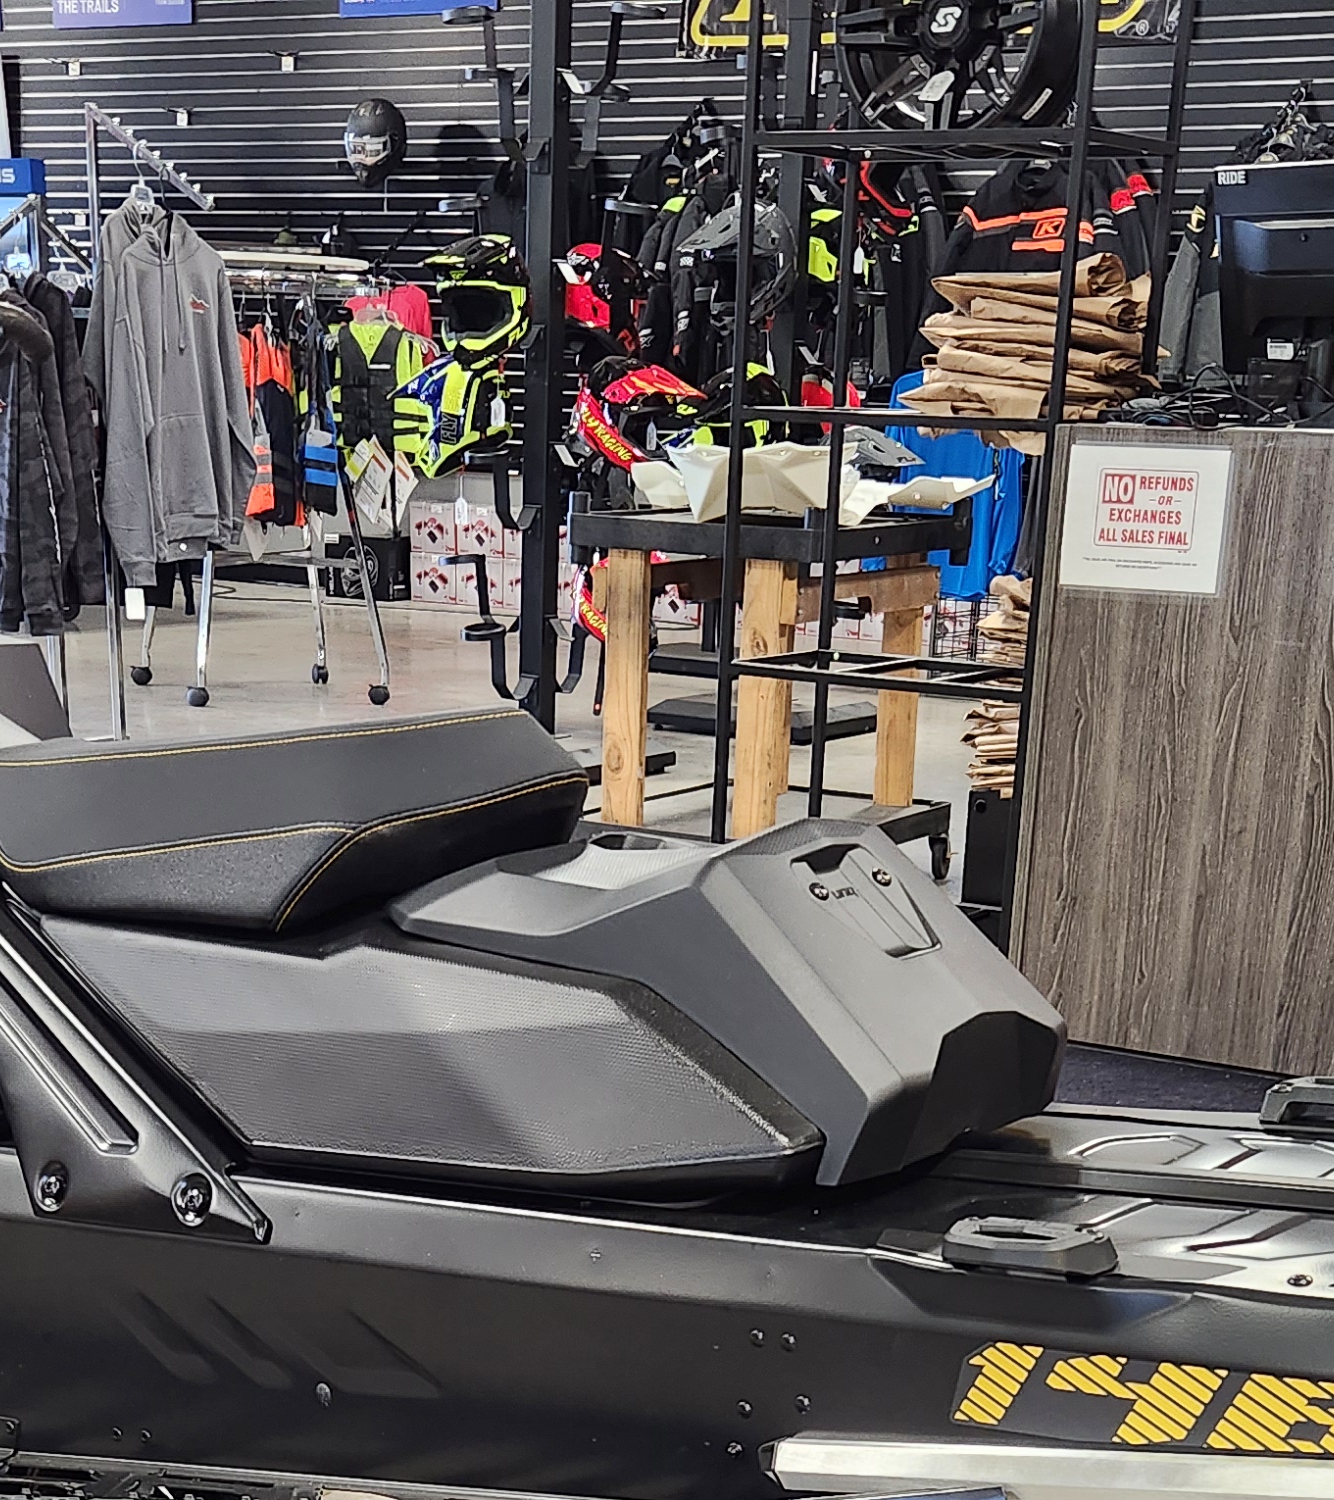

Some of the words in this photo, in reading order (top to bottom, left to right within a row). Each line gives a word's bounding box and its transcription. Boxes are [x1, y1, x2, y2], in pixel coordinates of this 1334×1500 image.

[58, 0, 78, 13] THE
[81, 0, 119, 13] TRAILS
[1218, 171, 1246, 185] RIDE
[595, 425, 632, 461] RACING
[1104, 475, 1134, 503] NO
[1139, 476, 1194, 492] REFUNDS
[1108, 508, 1182, 525] EXCHANGES
[1098, 528, 1117, 542] ALL
[1121, 529, 1154, 544] SALES
[1157, 531, 1189, 546] FINAL
